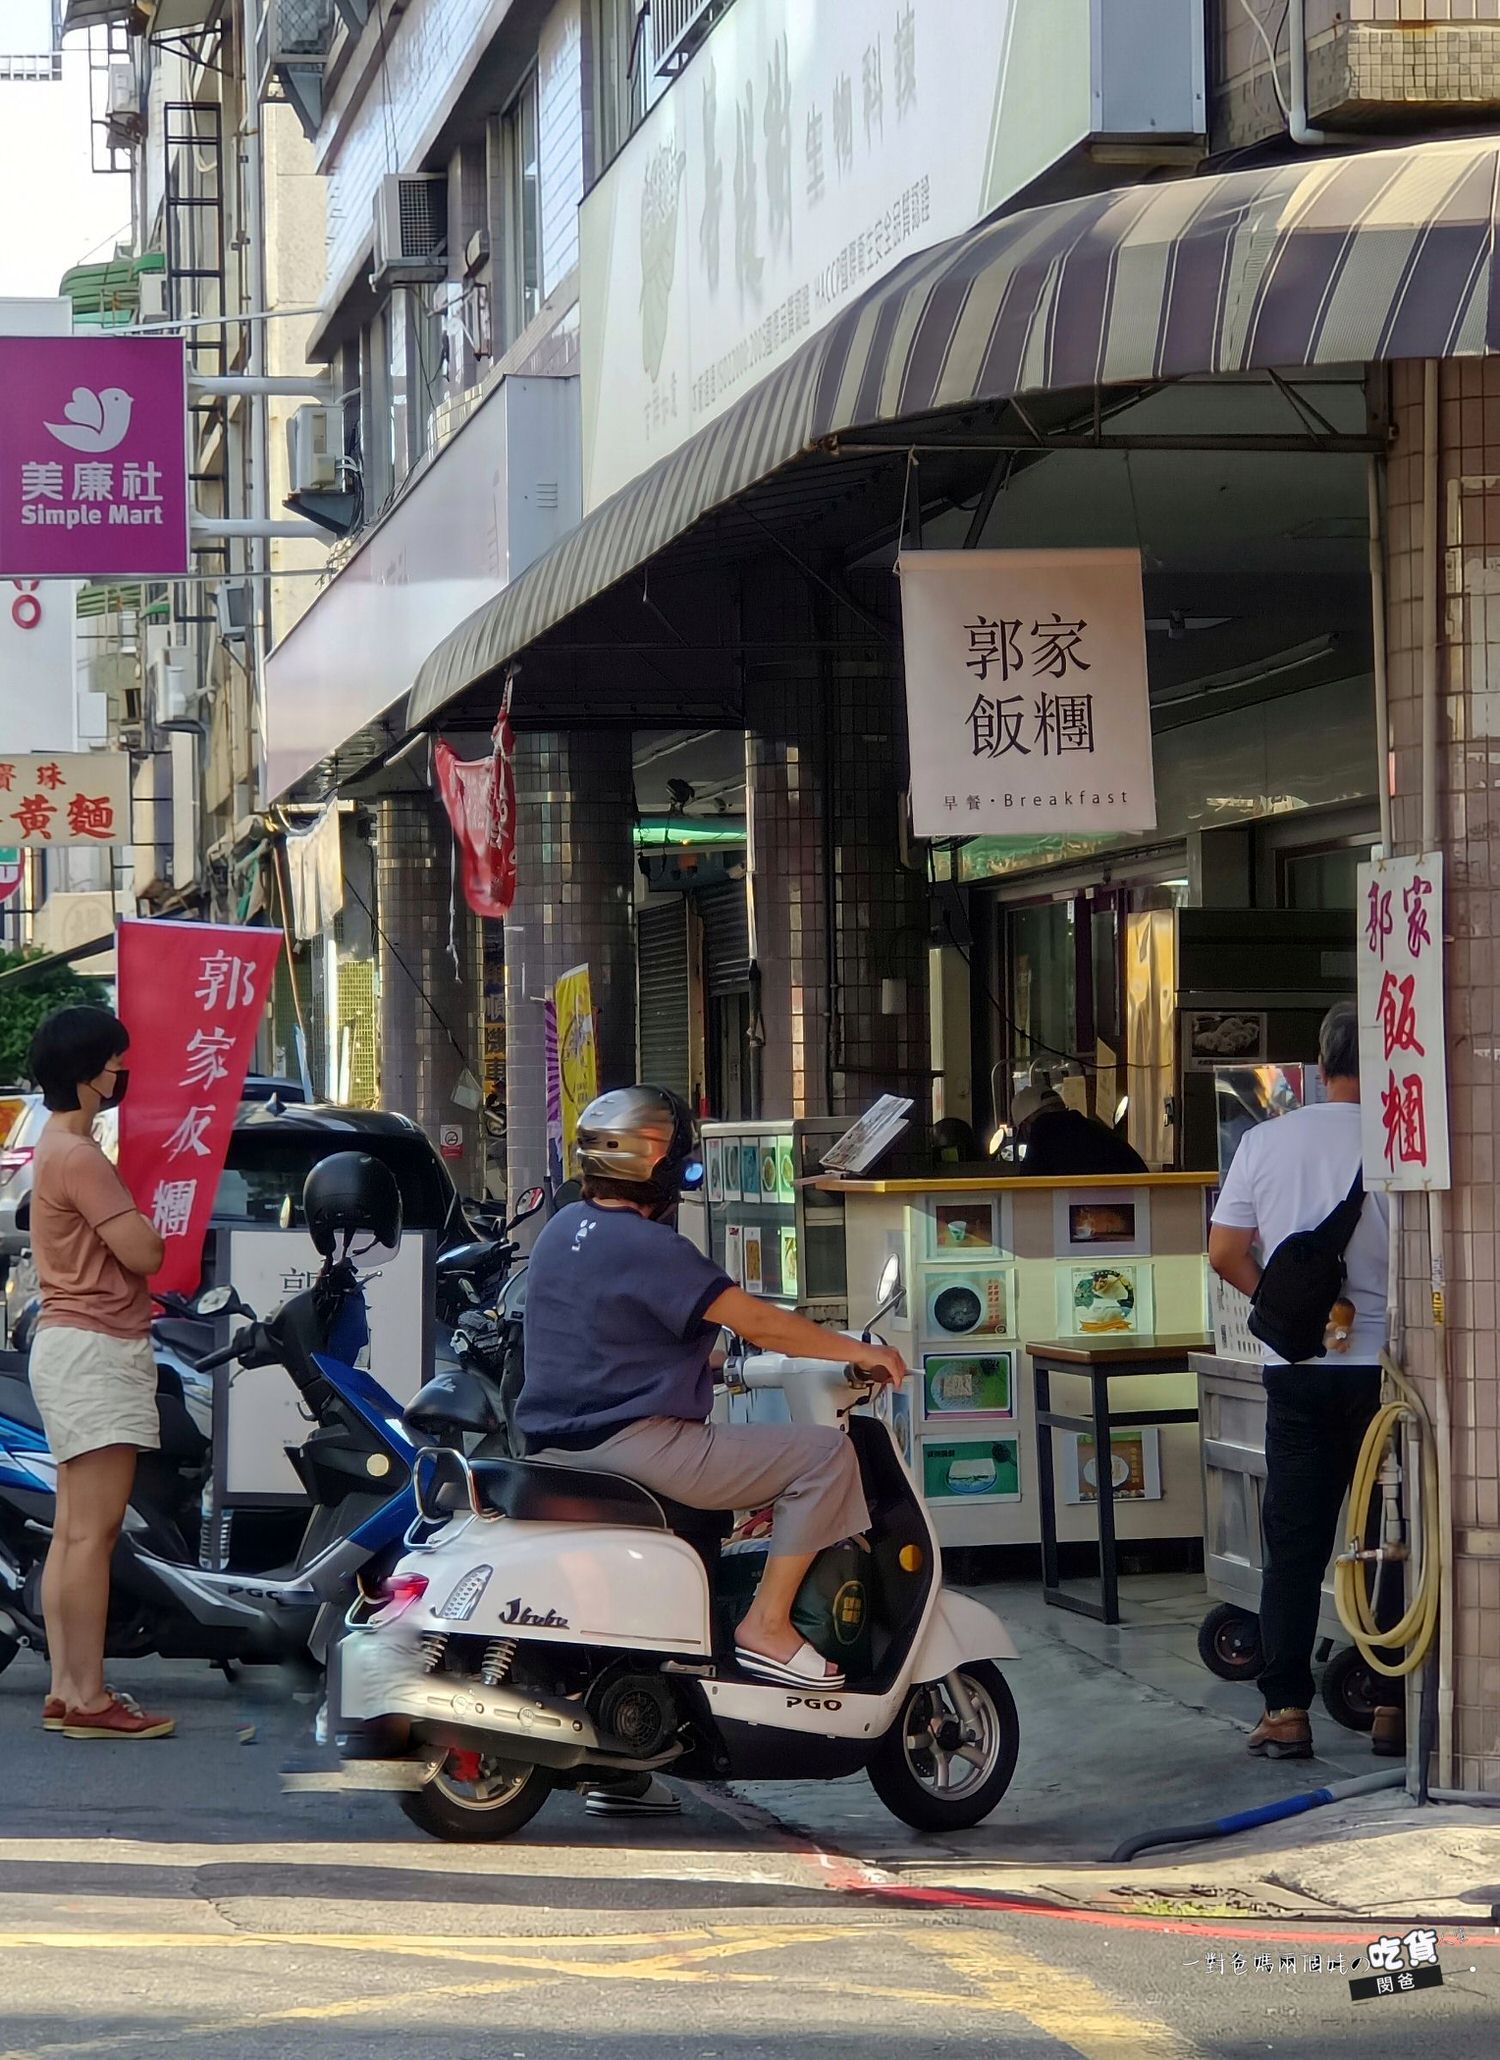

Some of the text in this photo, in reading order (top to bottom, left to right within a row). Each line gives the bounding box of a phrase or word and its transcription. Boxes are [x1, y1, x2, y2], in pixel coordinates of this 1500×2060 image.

[21, 461, 164, 501] 美廉社
[21, 503, 164, 530] Simple Mart
[963, 613, 1092, 682] 郭家
[965, 691, 1095, 759] 飯糰
[785, 1696, 842, 1711] PGO
